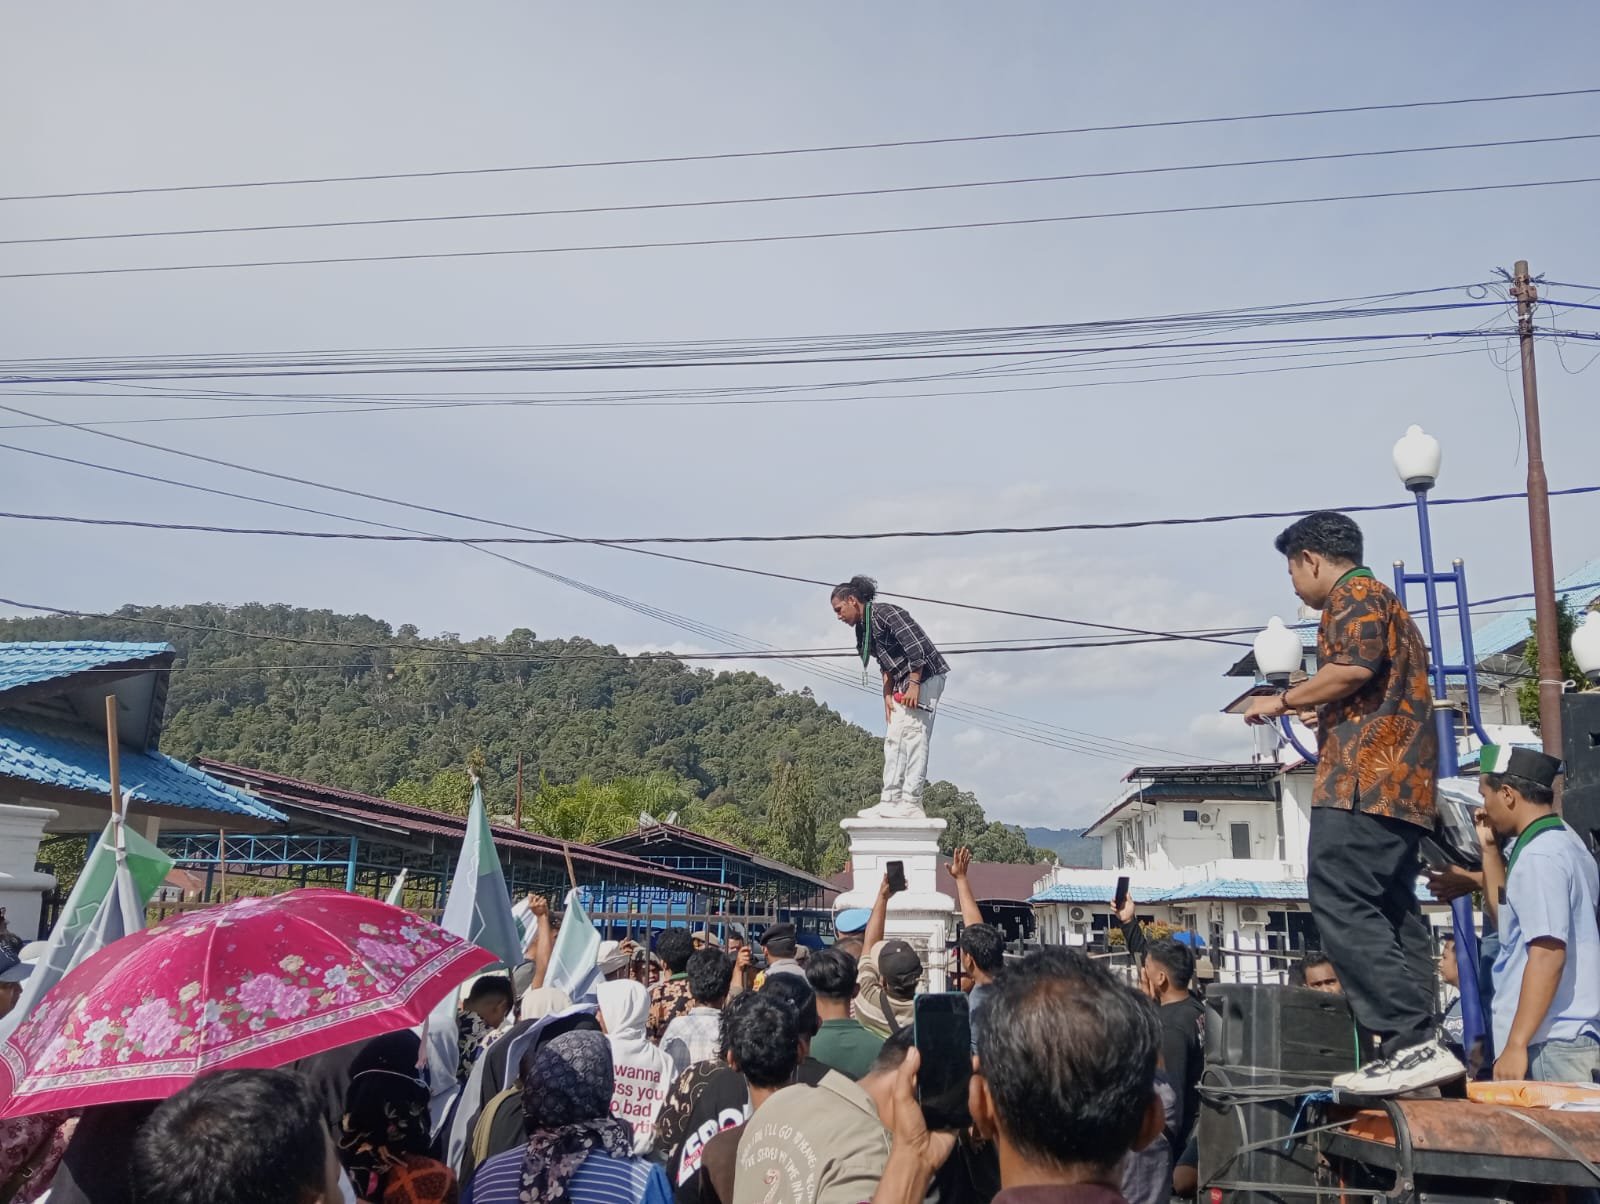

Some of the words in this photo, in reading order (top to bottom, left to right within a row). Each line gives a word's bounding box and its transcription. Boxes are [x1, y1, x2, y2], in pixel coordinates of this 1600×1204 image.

[614, 1064, 661, 1083] wanna
[612, 1079, 634, 1097] iss
[636, 1086, 664, 1102] you
[610, 1099, 620, 1112] o
[623, 1099, 652, 1117] bad
[779, 1124, 793, 1139] GO
